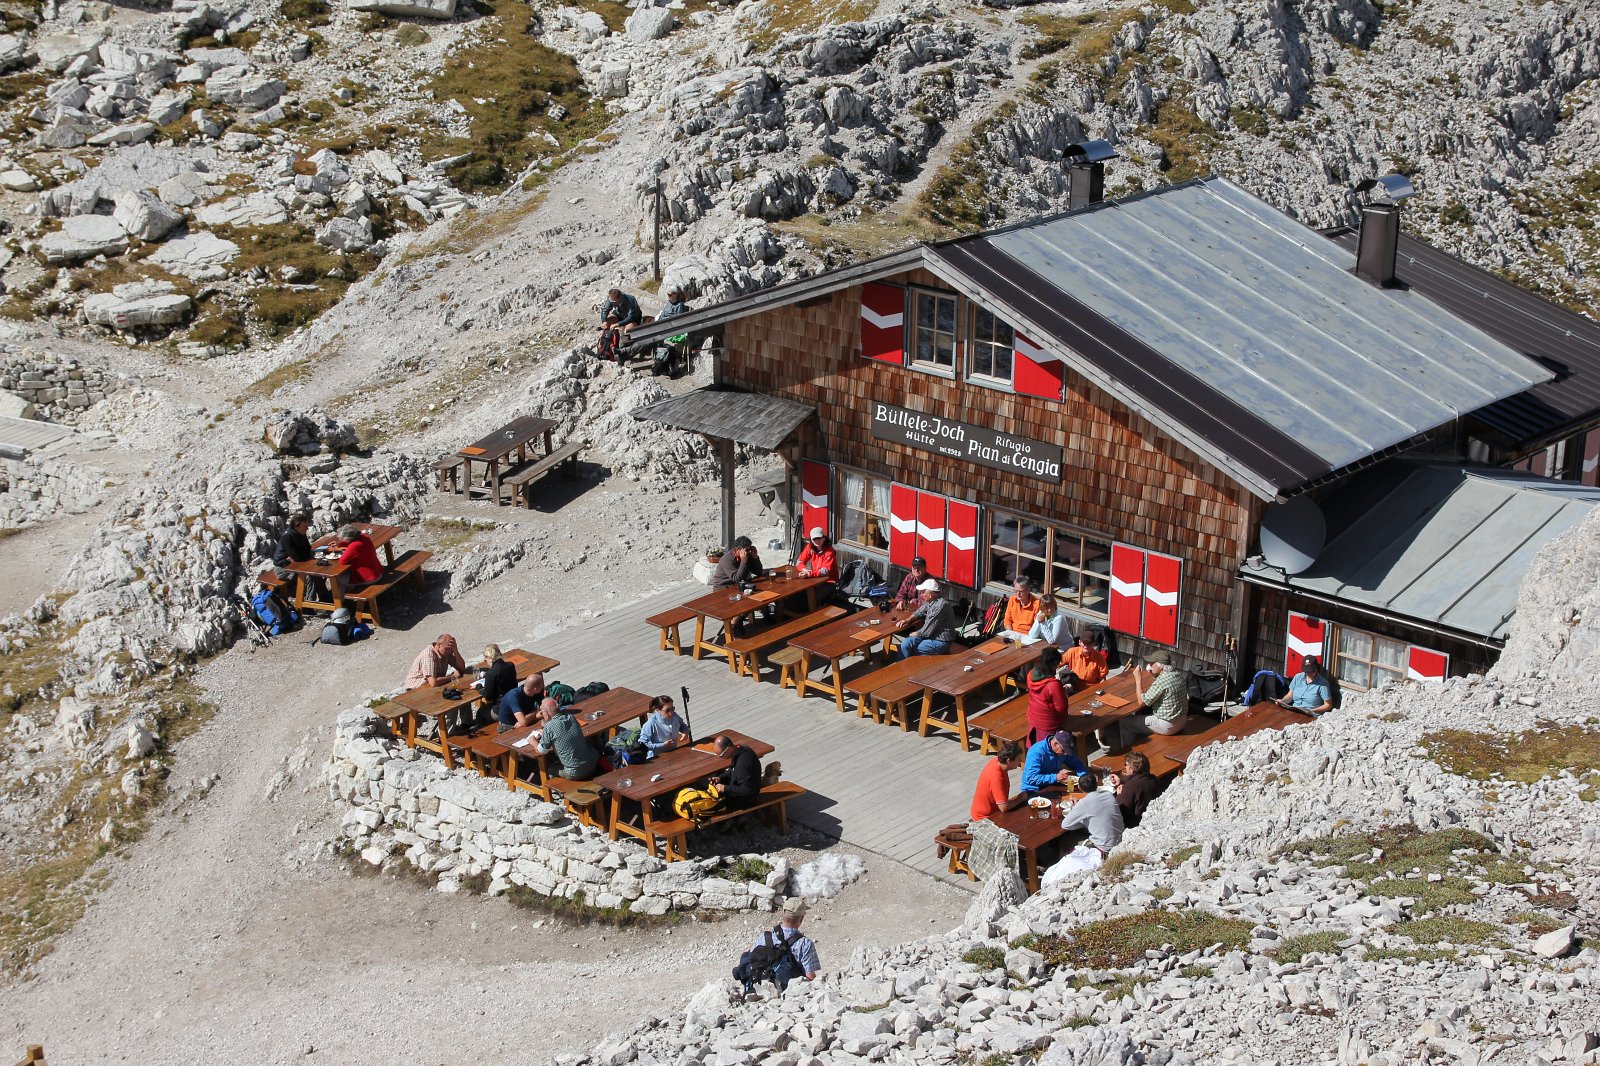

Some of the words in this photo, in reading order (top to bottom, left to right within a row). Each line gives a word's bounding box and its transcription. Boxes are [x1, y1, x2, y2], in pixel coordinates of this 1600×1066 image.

[905, 430, 935, 446] Hütte
[995, 435, 1031, 453] Rifugio
[968, 439, 999, 462] Pian
[1001, 454, 1010, 465] di
[1012, 452, 1060, 477] Cengia
